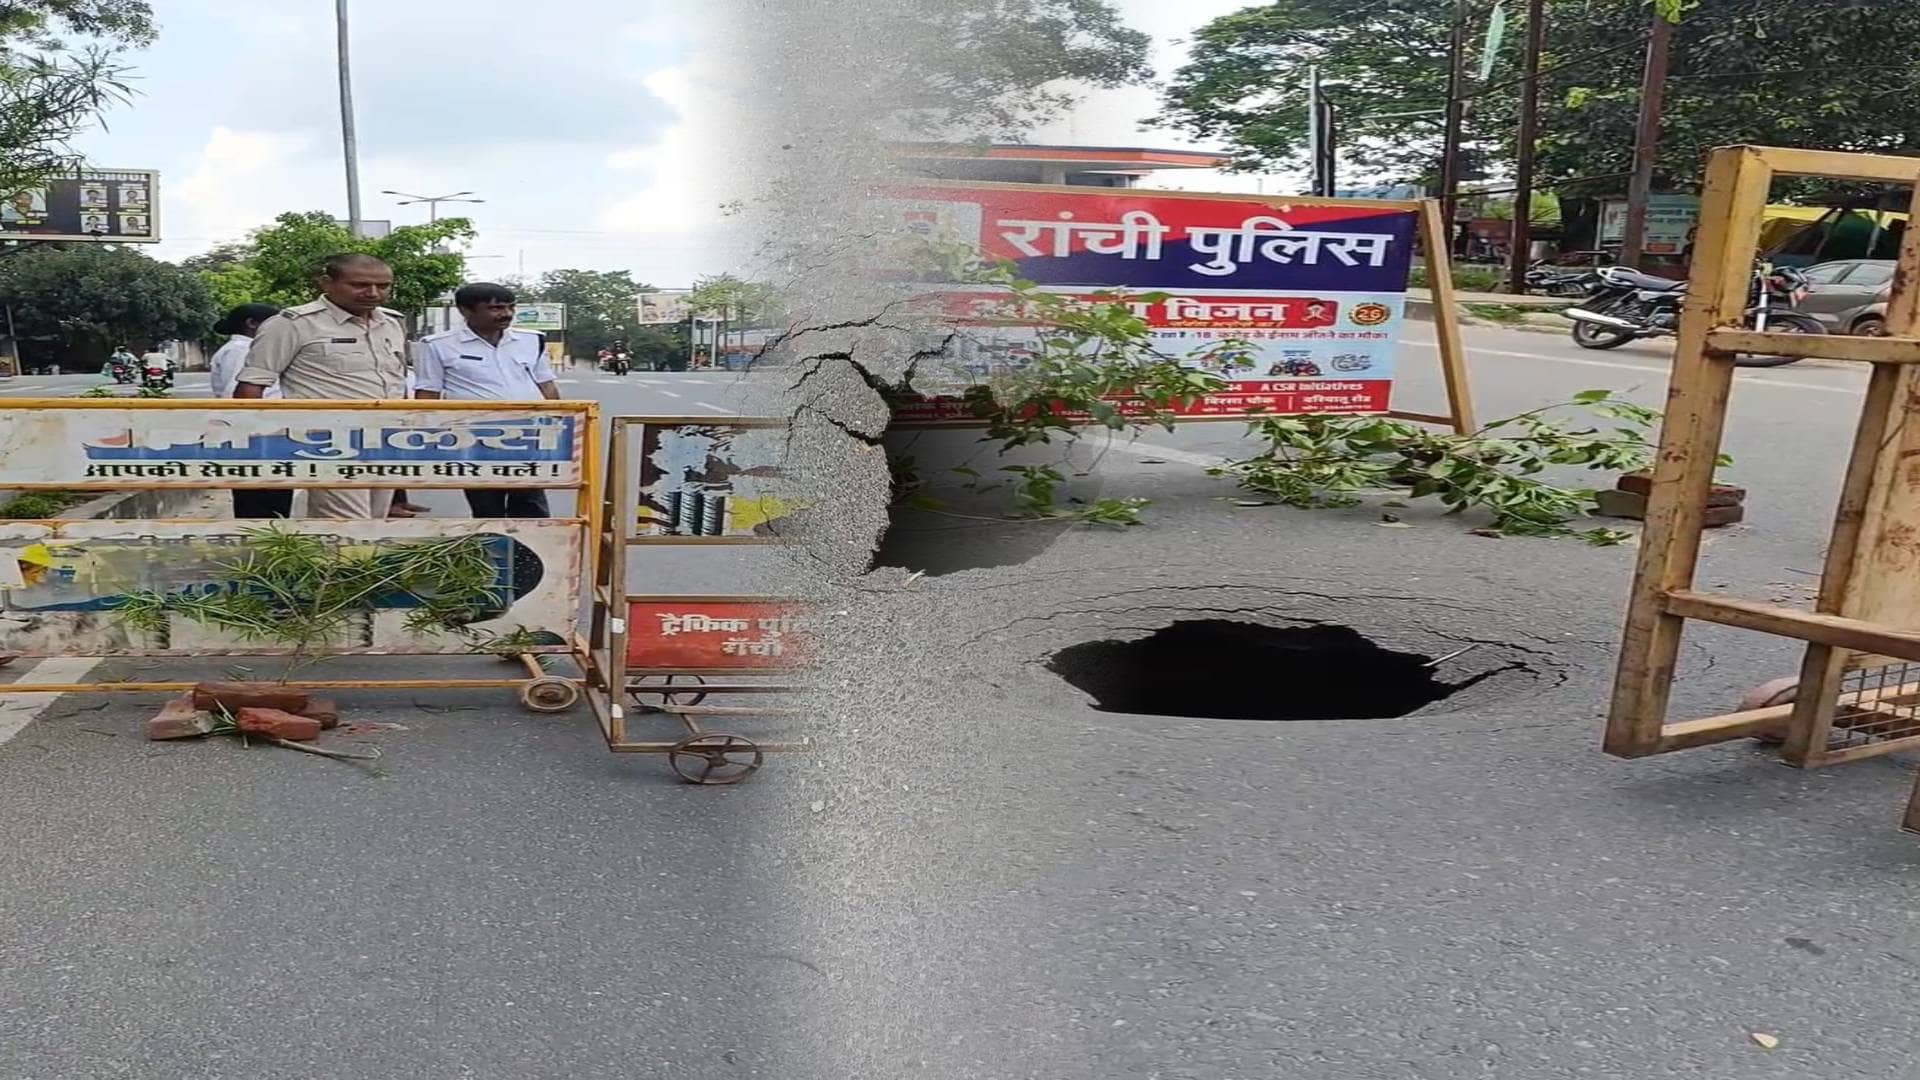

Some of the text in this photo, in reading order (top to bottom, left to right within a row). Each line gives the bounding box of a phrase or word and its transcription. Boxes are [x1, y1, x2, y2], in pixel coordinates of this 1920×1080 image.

[82, 172, 148, 182] SCHOOL
[997, 211, 1393, 276] रांची पुलिस
[1164, 297, 1291, 321] विजन
[1359, 308, 1380, 320] 26
[1261, 383, 1270, 392] A
[84, 461, 188, 477] आपकी
[200, 461, 263, 477] सेवा
[271, 461, 297, 477] में
[337, 463, 425, 479] कृपया
[433, 461, 483, 477] धीरे
